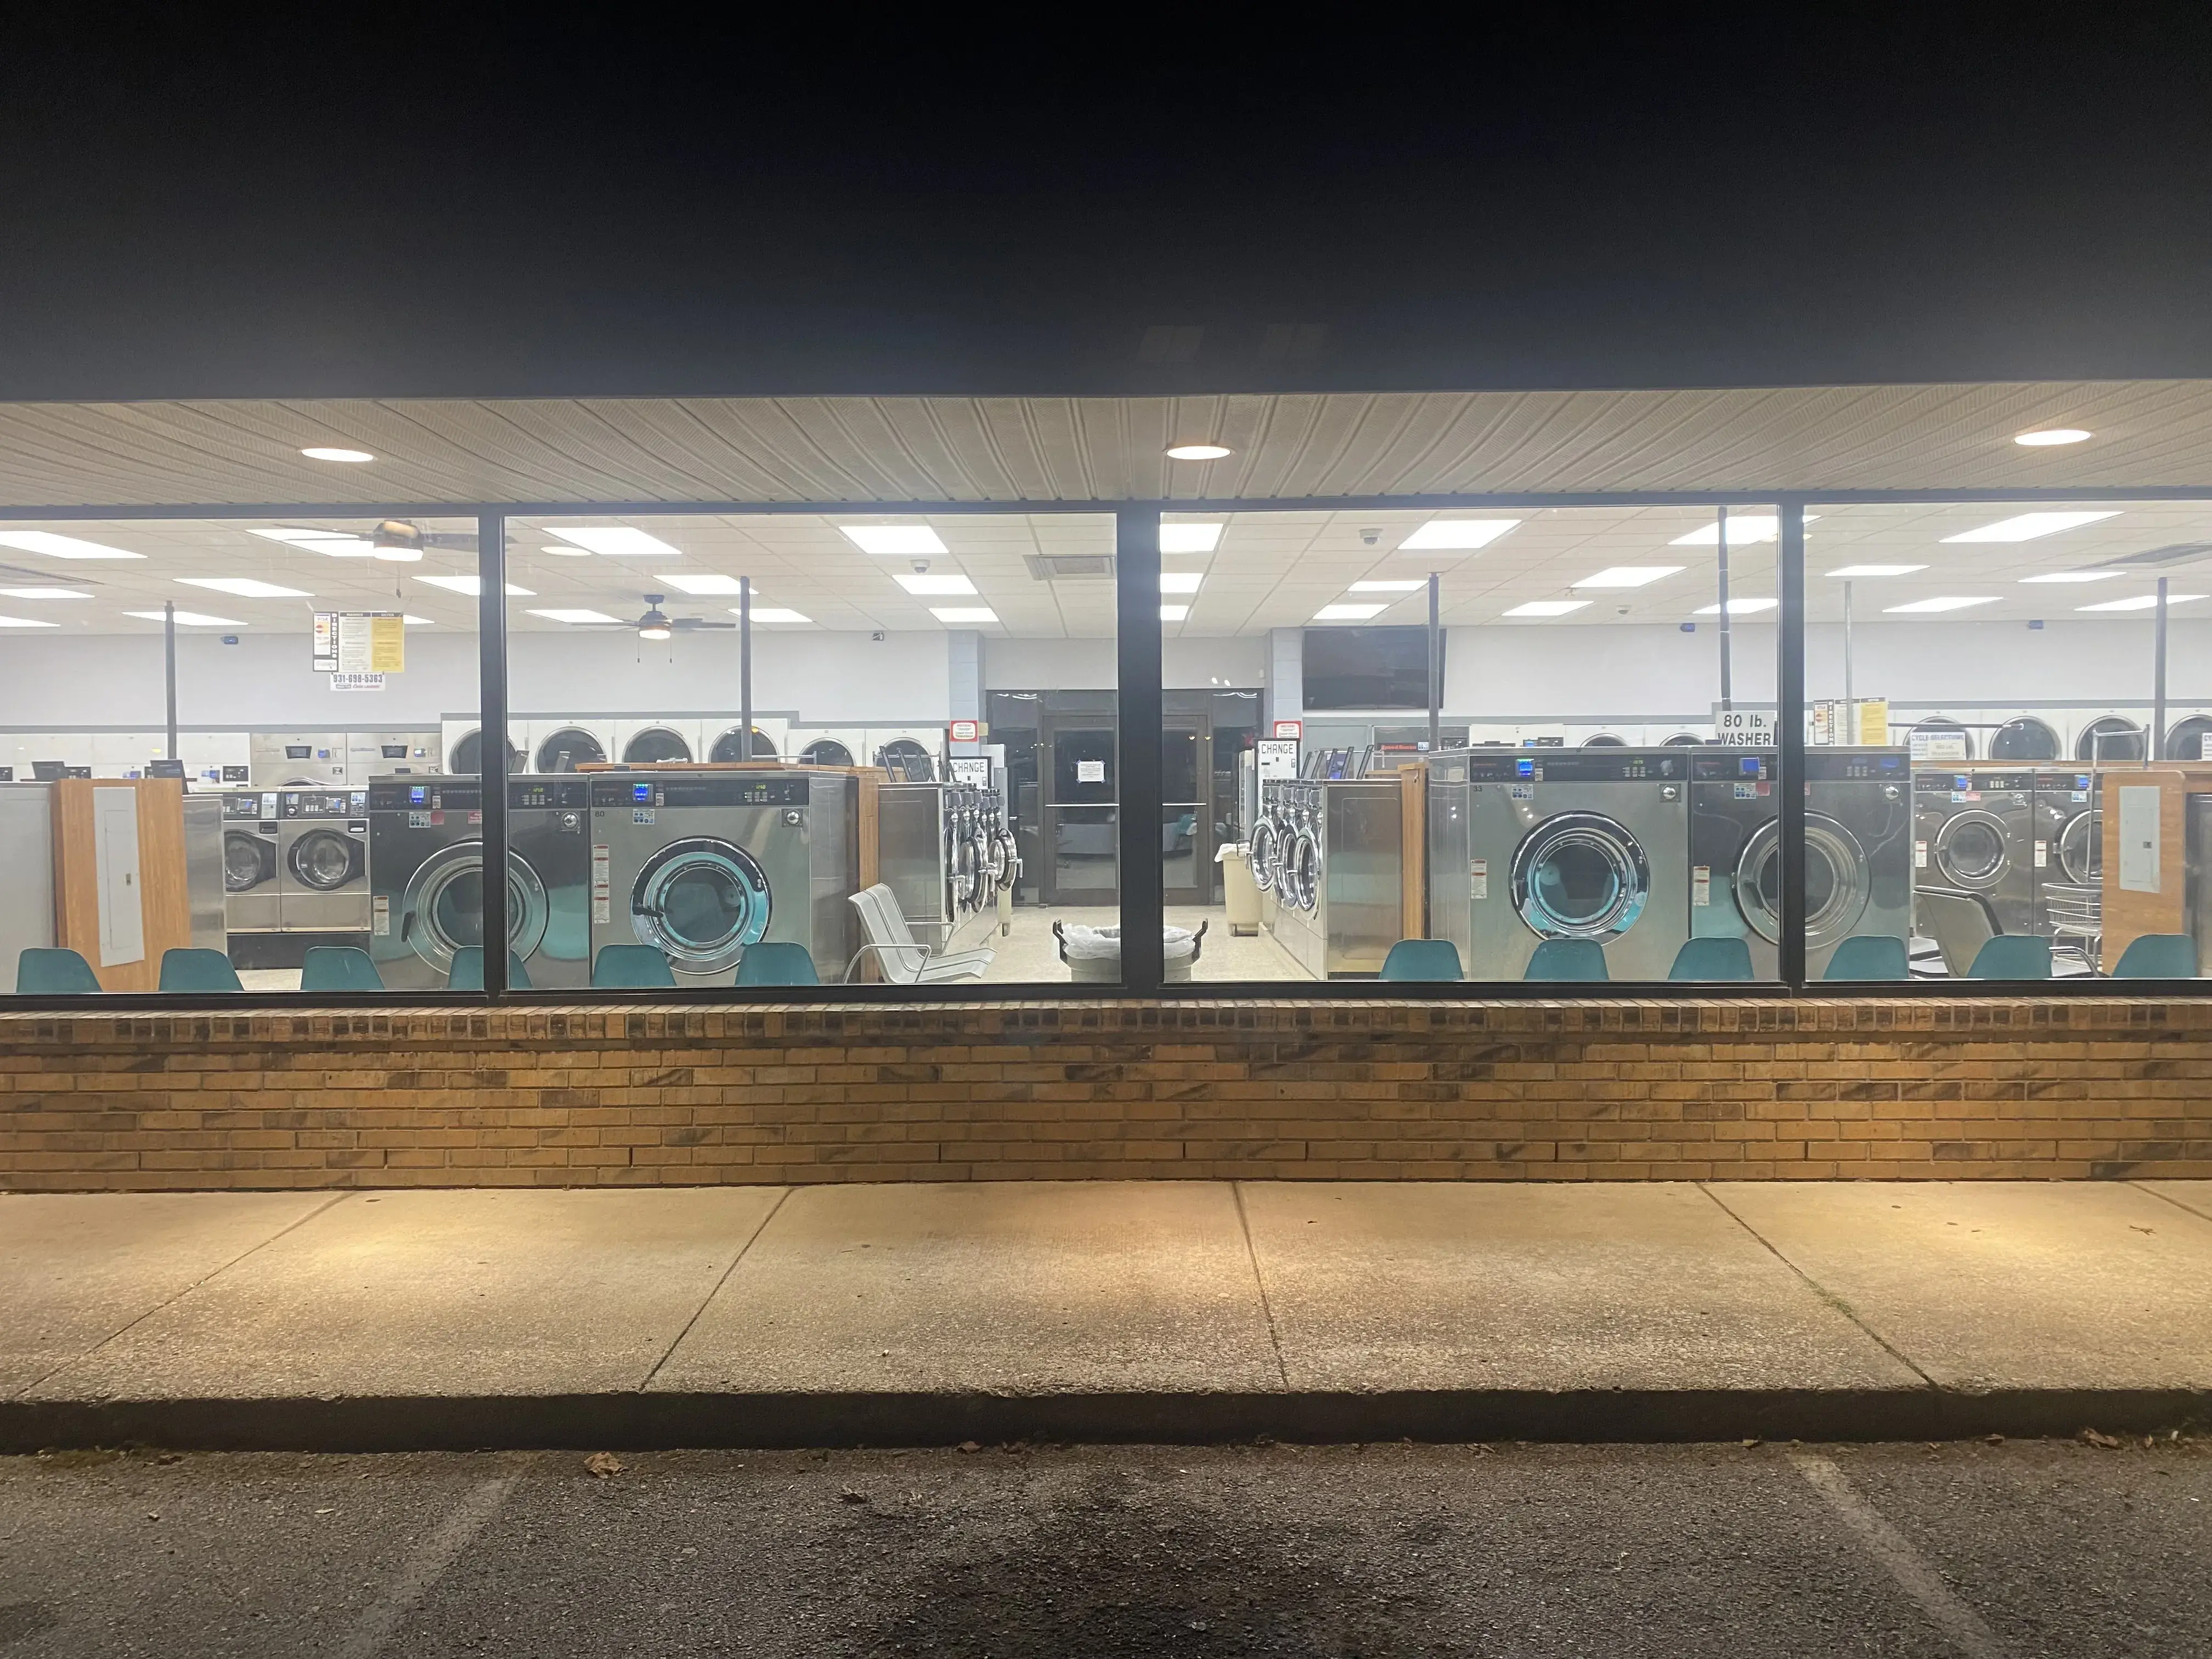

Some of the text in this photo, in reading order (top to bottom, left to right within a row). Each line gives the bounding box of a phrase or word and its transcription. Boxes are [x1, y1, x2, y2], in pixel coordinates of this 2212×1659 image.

[1724, 715, 1767, 727] 80 lb.
[1718, 732, 1771, 745] WASHER
[1262, 744, 1294, 754] CHANGE
[953, 762, 985, 772] CHANGE
